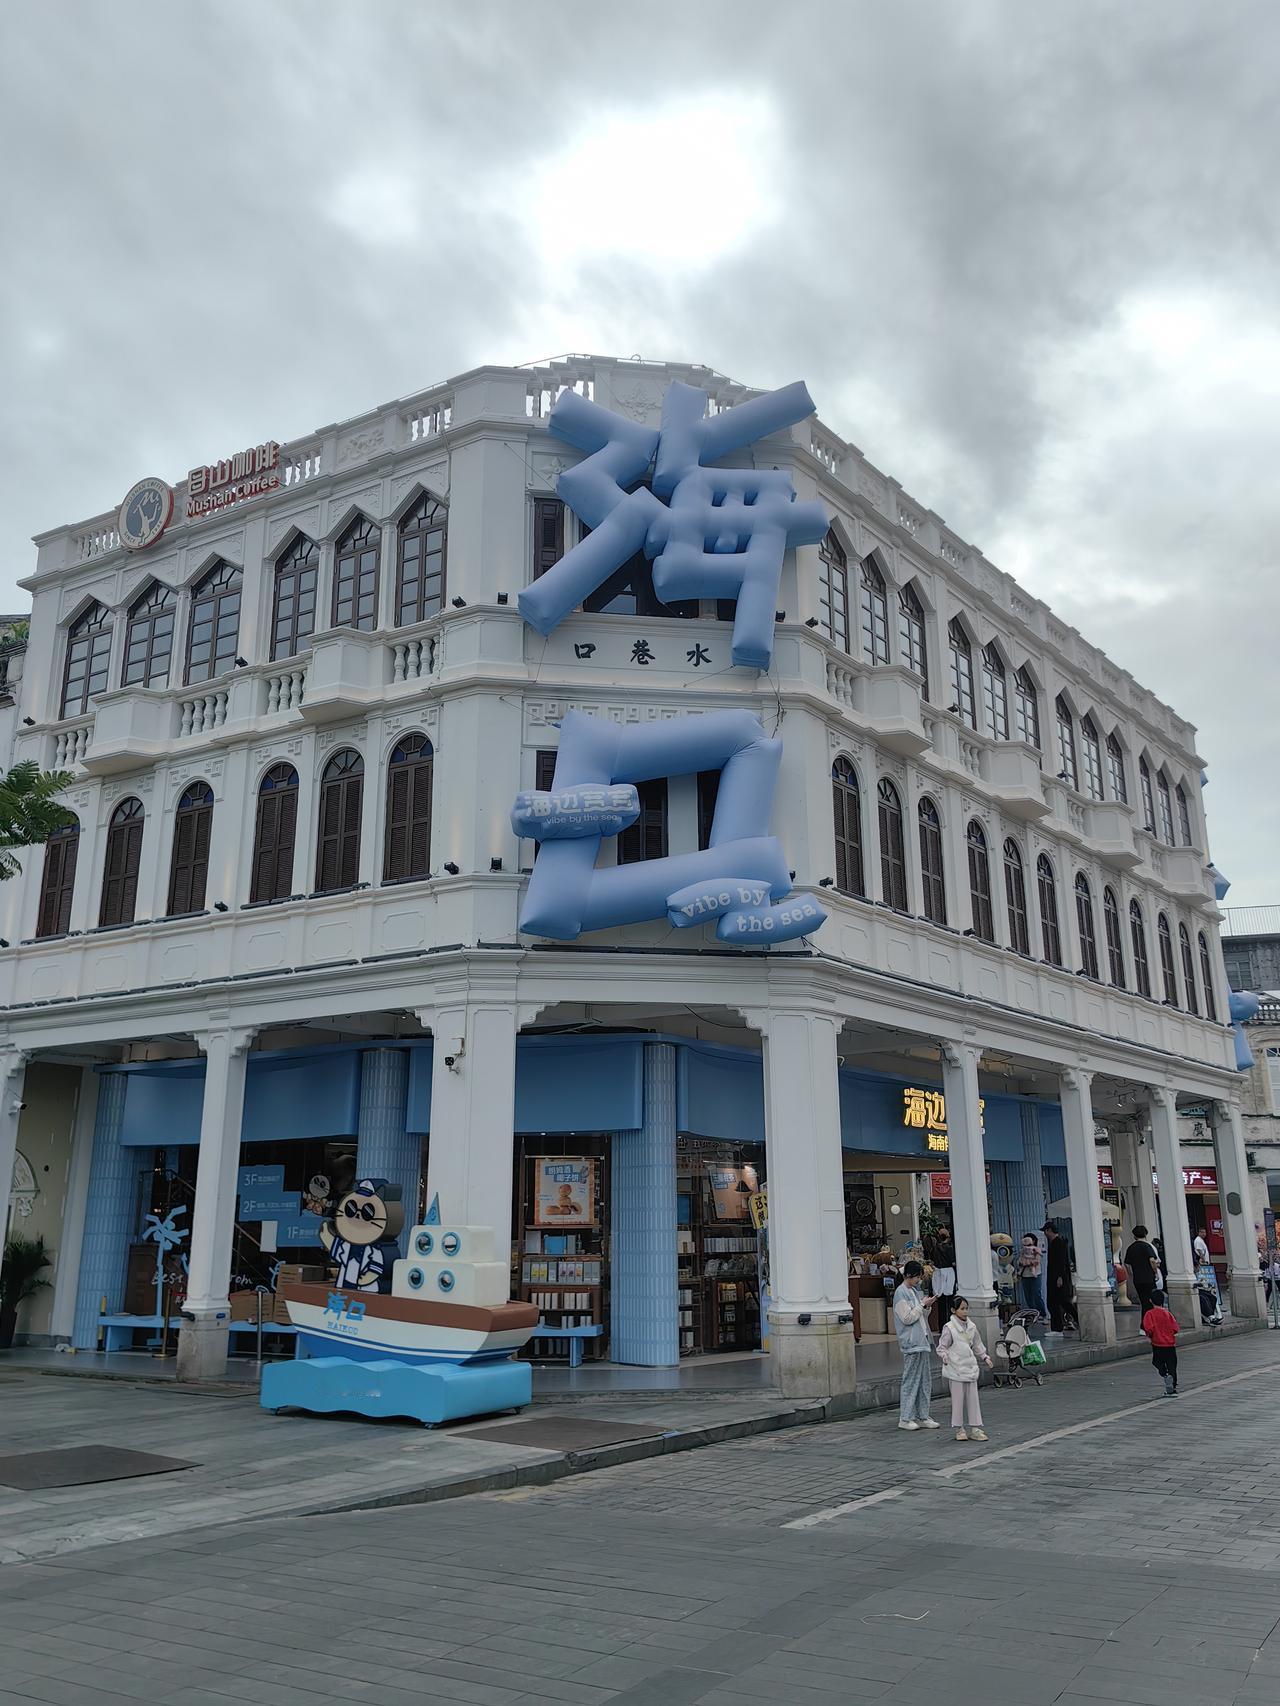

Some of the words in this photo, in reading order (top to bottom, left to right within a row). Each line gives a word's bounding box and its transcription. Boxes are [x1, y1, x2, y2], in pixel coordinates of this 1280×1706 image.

[186, 490, 232, 516] Mushan
[235, 474, 278, 499] Coffee
[546, 816, 567, 825] vibe
[569, 815, 582, 824] by
[583, 813, 599, 822] the
[681, 892, 731, 918] vibe
[737, 887, 766, 906] by
[736, 915, 774, 932] the
[780, 903, 817, 926] sea
[244, 1173, 258, 1186] 3F
[243, 1200, 257, 1213] 2F
[287, 1226, 299, 1239] 1F
[323, 1291, 366, 1321] 海口
